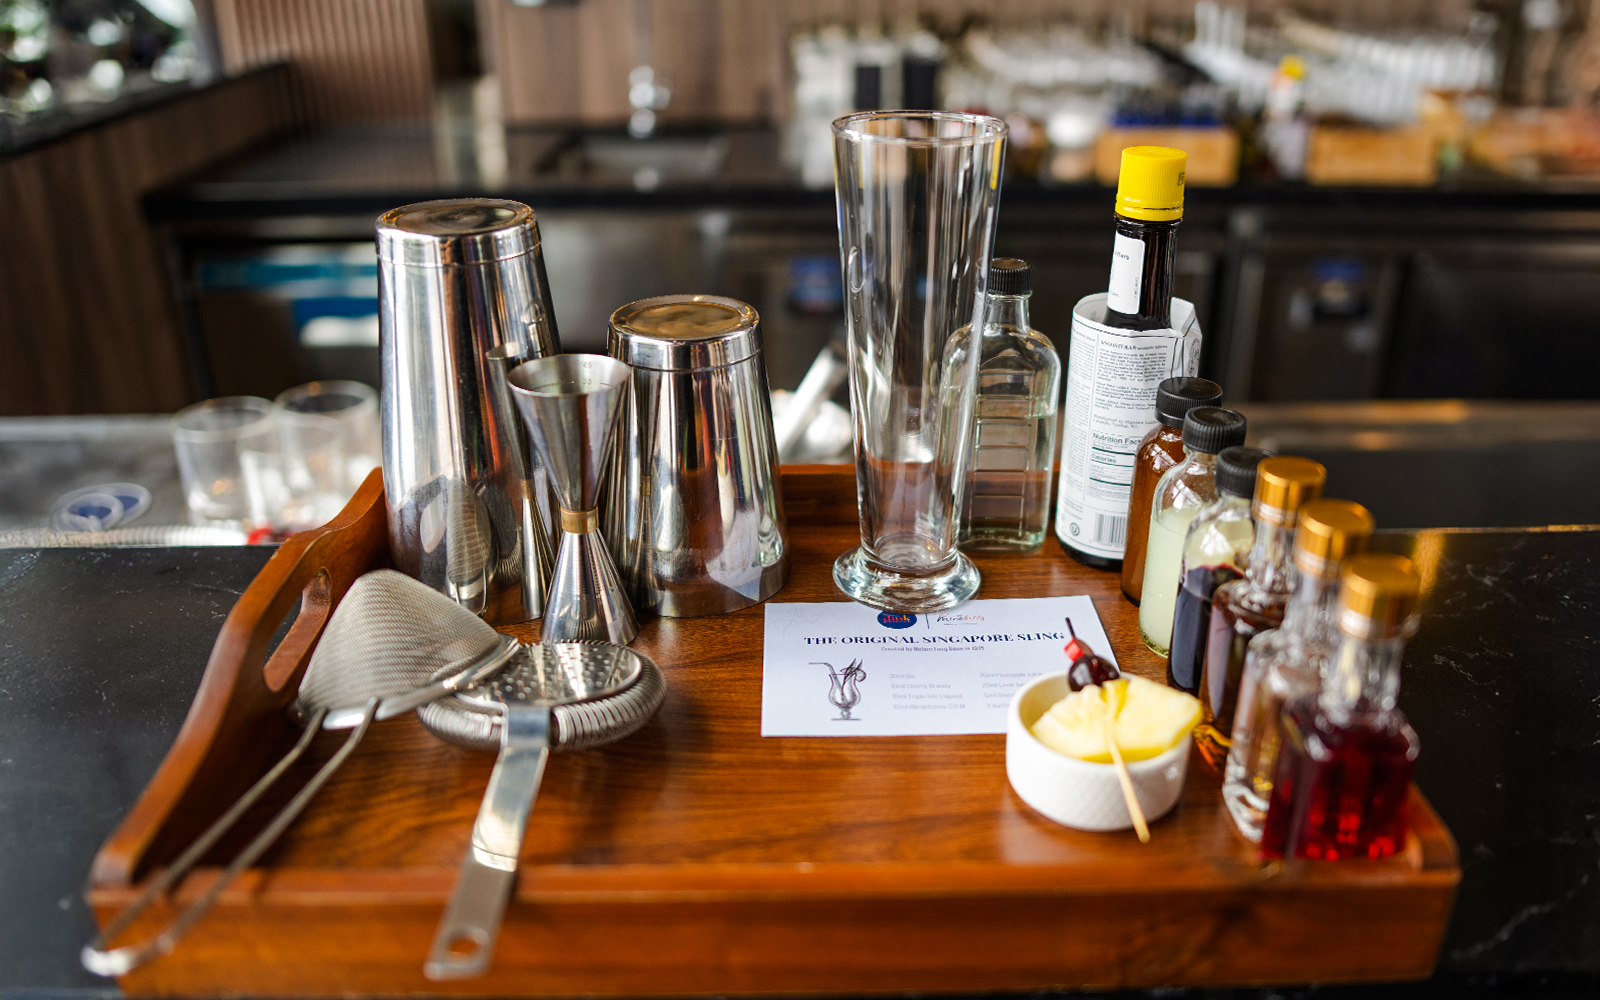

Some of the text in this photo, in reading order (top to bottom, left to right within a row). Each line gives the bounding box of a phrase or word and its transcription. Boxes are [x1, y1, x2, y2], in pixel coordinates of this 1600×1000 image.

[1092, 432, 1123, 444] Nutrition
[1091, 454, 1116, 463] Calories
[804, 632, 1064, 645] THE ORIGINAL SINGAPORE SLING
